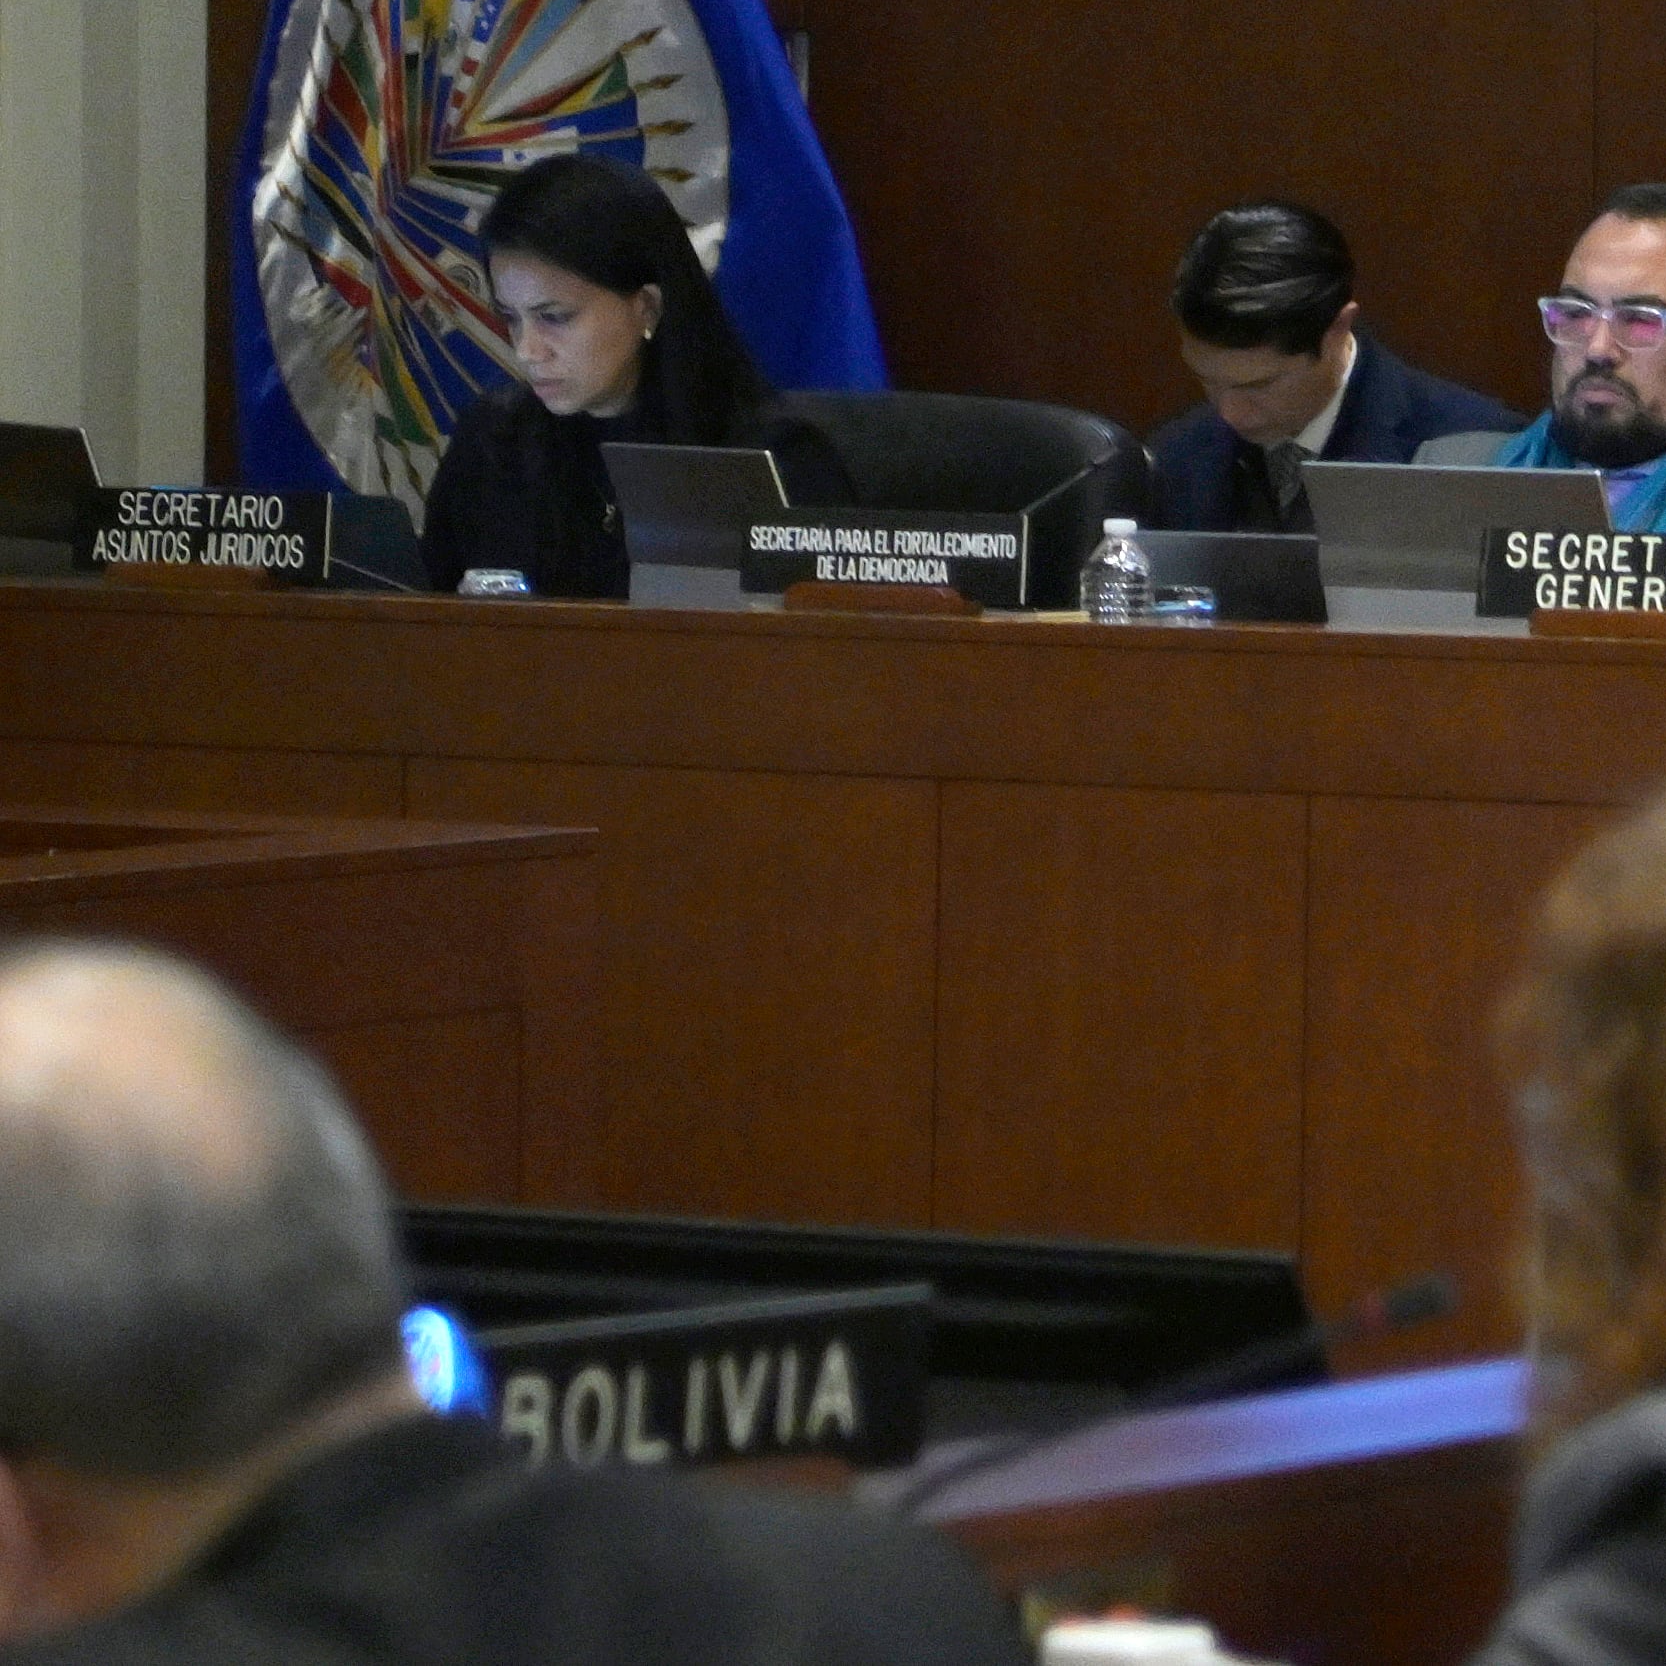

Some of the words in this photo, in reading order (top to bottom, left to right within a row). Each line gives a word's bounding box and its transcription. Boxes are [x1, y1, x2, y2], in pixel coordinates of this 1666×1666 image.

[118, 491, 283, 530] SECRETARIO
[92, 528, 191, 564] ASUNTOS
[200, 532, 305, 568] JURIDICOS
[750, 525, 832, 552] SECRETARIA
[835, 527, 871, 553] PARA
[874, 530, 891, 555] EL
[894, 530, 1016, 559] FORTALECIMIENTO
[817, 555, 836, 580] DE
[838, 556, 857, 581] LA
[859, 557, 949, 583] DEMOCRACIA
